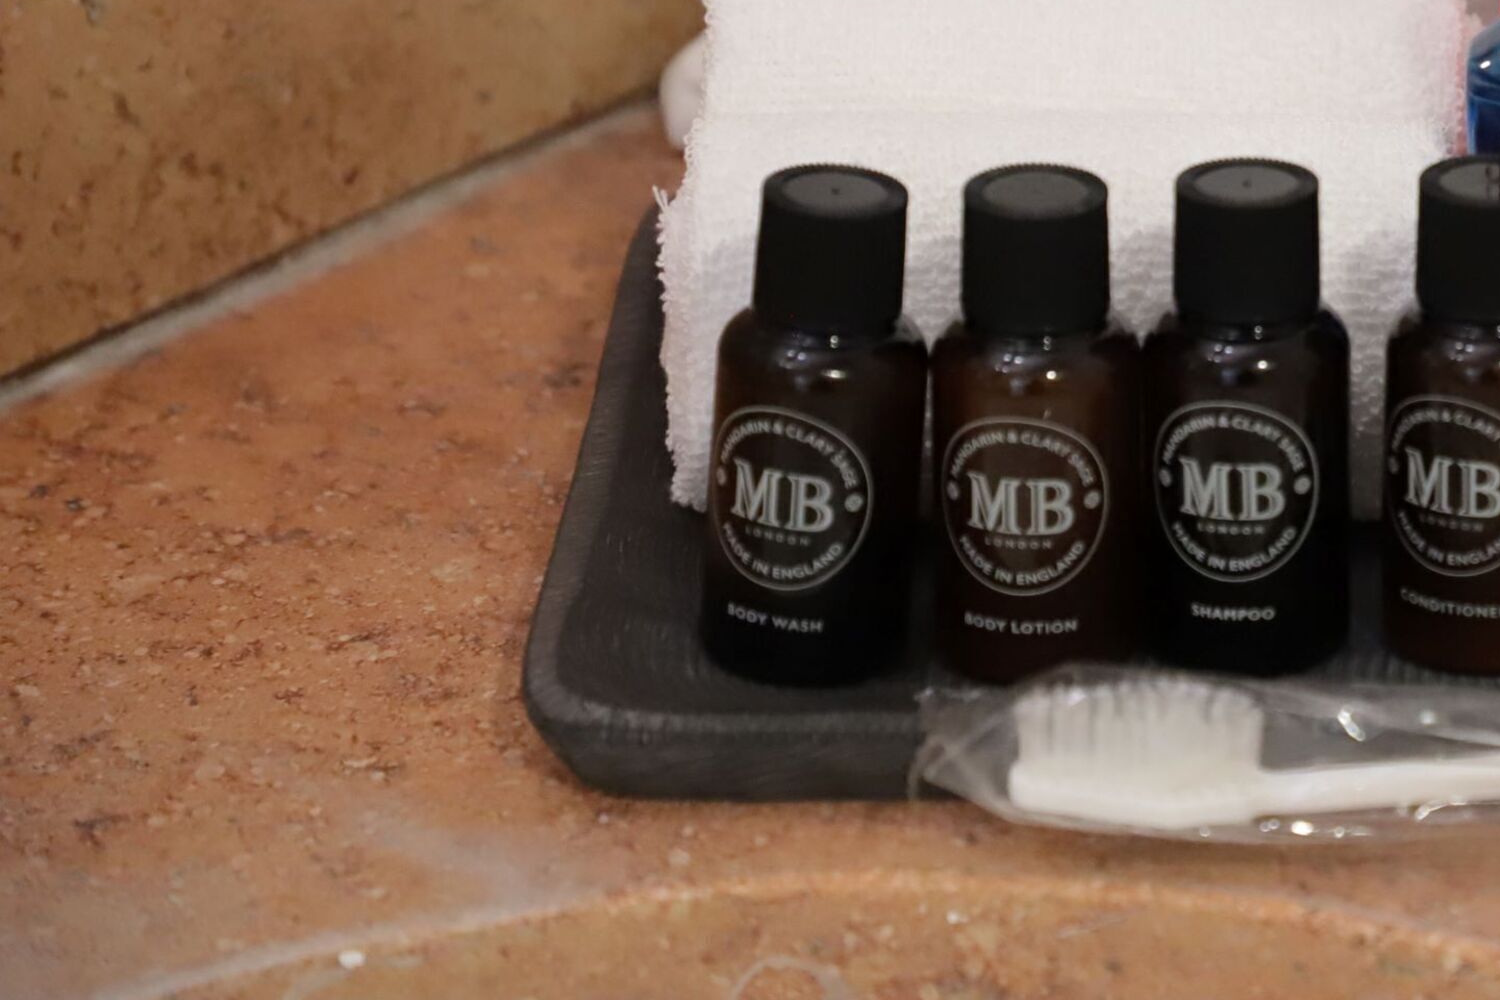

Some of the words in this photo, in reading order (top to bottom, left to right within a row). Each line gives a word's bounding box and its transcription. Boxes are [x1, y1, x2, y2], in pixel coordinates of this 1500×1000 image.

[731, 457, 835, 533] MB
[966, 470, 1076, 536] MB
[1178, 454, 1287, 521] MB
[752, 558, 770, 577] IN
[772, 543, 844, 581] ENGLAND
[994, 568, 1013, 585] IN
[1015, 541, 1086, 586] ENGLAND
[1207, 555, 1226, 571] IN
[1228, 526, 1298, 573] ENGLAND
[727, 600, 768, 626] BODY
[771, 615, 824, 634] WASH
[963, 611, 1007, 632] BODY
[1010, 618, 1079, 636] LOTION
[1190, 602, 1276, 622] SHAMPOO
